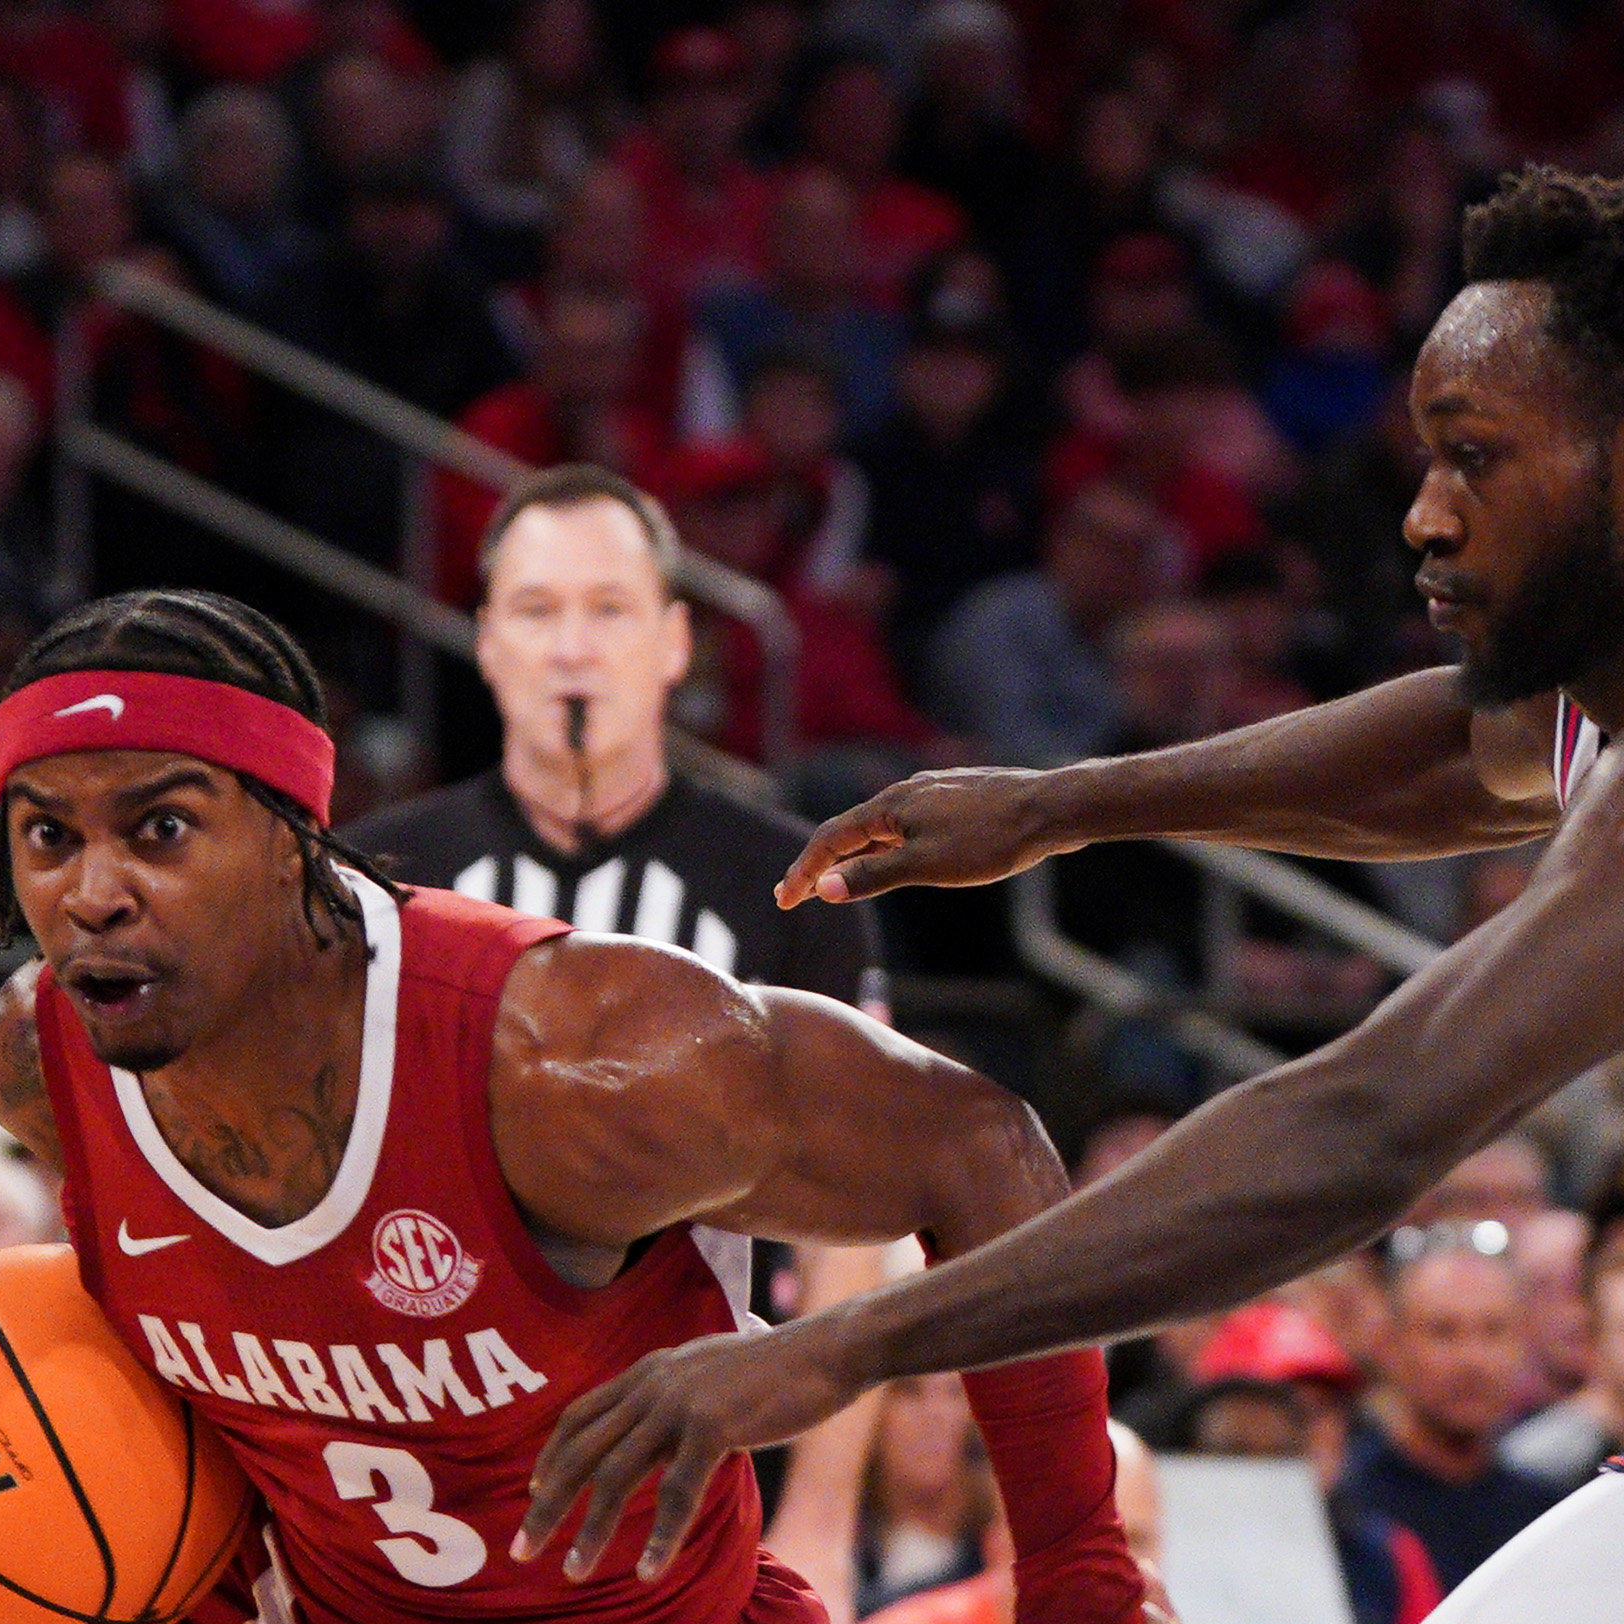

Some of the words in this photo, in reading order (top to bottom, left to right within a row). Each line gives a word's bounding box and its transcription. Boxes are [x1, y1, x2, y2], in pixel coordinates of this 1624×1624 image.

[379, 1216, 454, 1291] SEC
[138, 1313, 548, 1423] ALABAMA
[322, 1441, 488, 1588] 3
